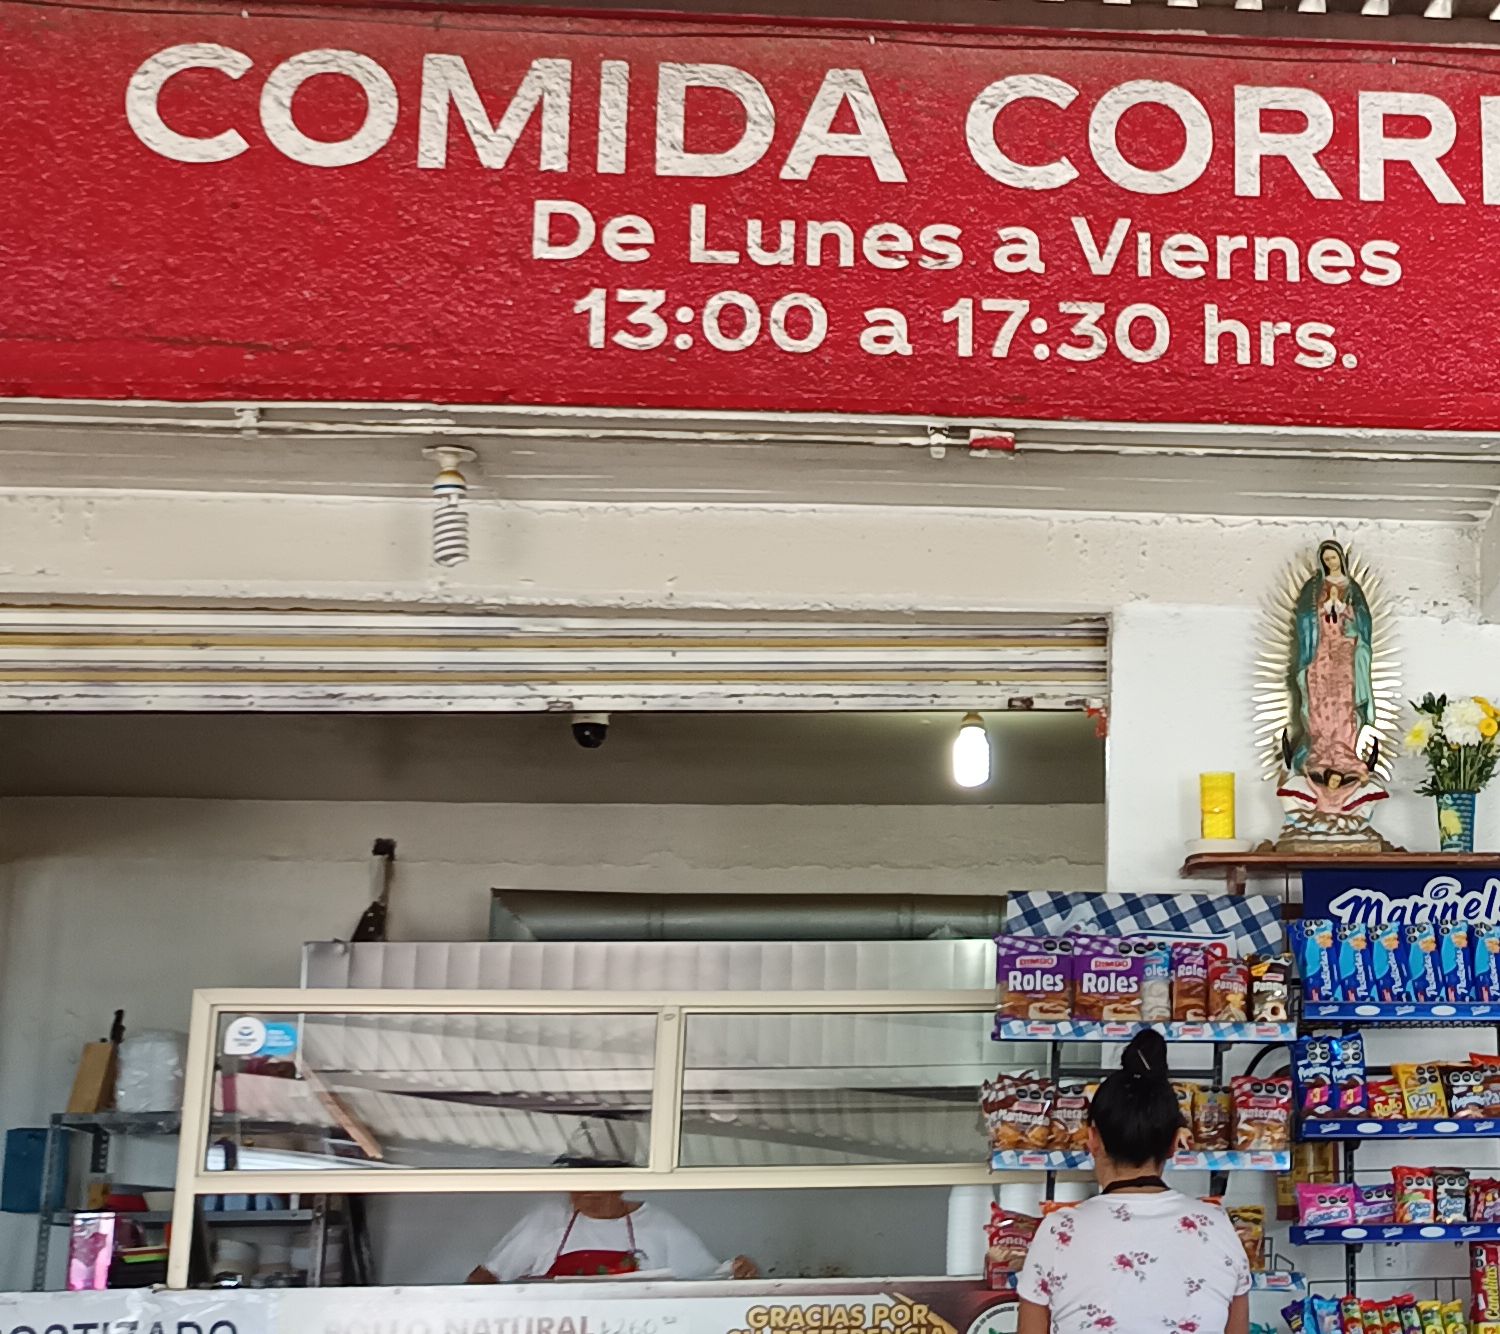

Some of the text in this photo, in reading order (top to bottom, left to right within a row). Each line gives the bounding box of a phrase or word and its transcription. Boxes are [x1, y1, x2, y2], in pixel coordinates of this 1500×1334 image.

[125, 43, 907, 183] COMIDA
[533, 200, 1401, 286] De Lunes a Viernes
[574, 288, 1358, 370] 13:00 a 17:30 hrs.
[1008, 971, 1064, 992] Roles
[1082, 973, 1138, 993] Roles
[1145, 965, 1169, 977] oles
[746, 1303, 930, 1330] GRACIAS POR
